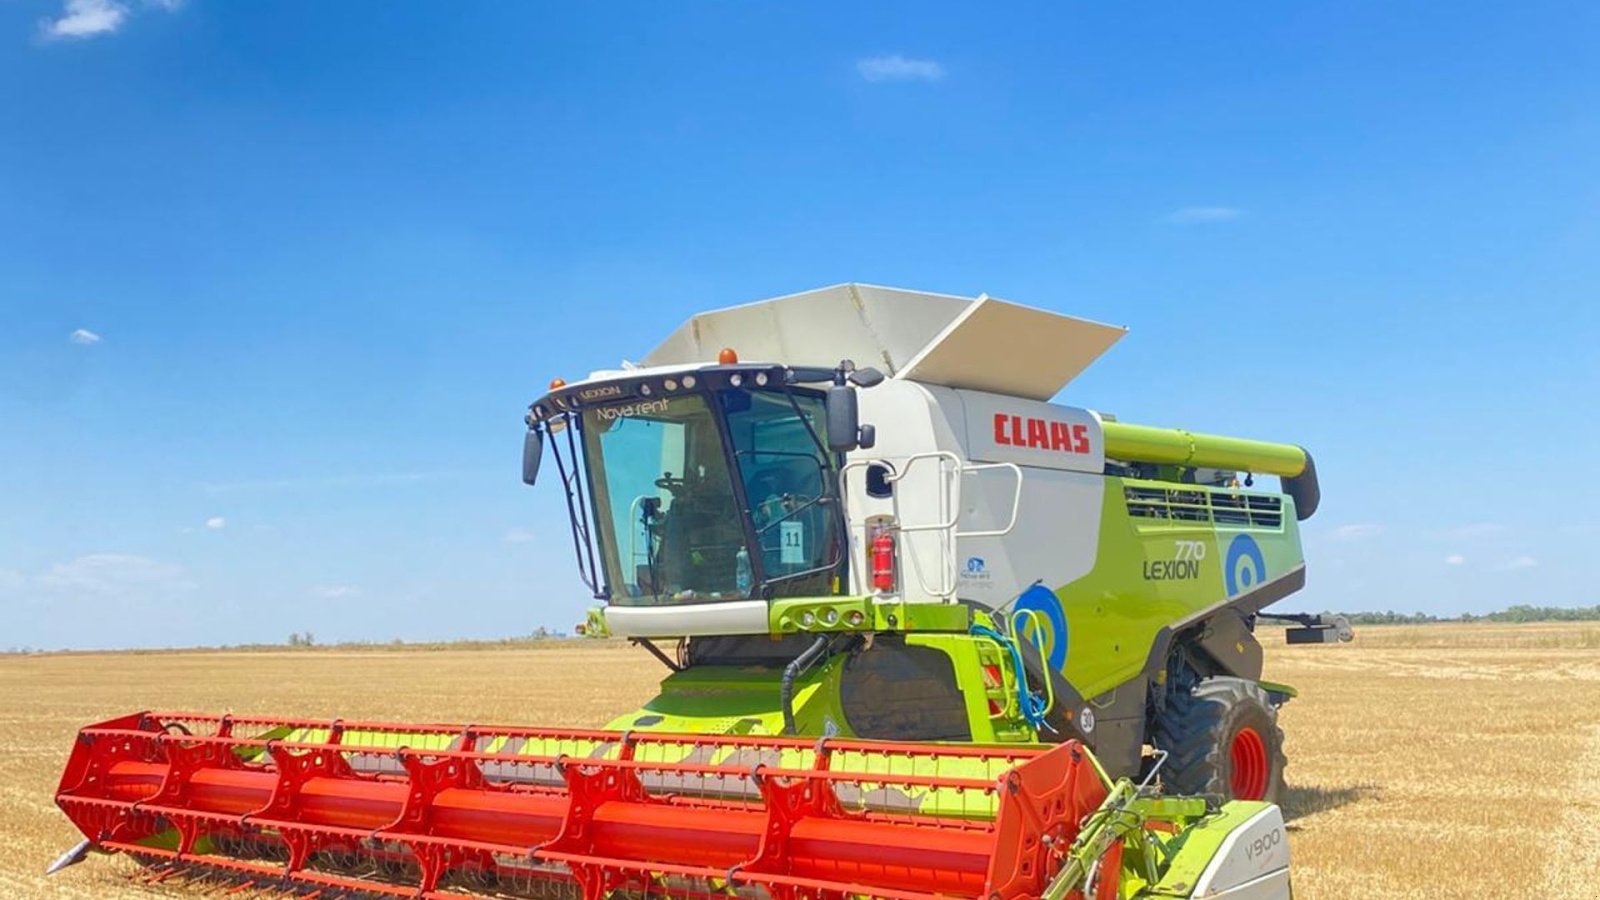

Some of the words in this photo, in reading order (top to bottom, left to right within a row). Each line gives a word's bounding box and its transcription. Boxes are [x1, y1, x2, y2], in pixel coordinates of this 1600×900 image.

[994, 413, 1090, 454] CLAAS
[785, 531, 801, 547] 11
[1175, 540, 1206, 561] 770
[1143, 560, 1199, 580] LEXION
[1083, 711, 1093, 728] 30
[1244, 828, 1281, 860] V900
